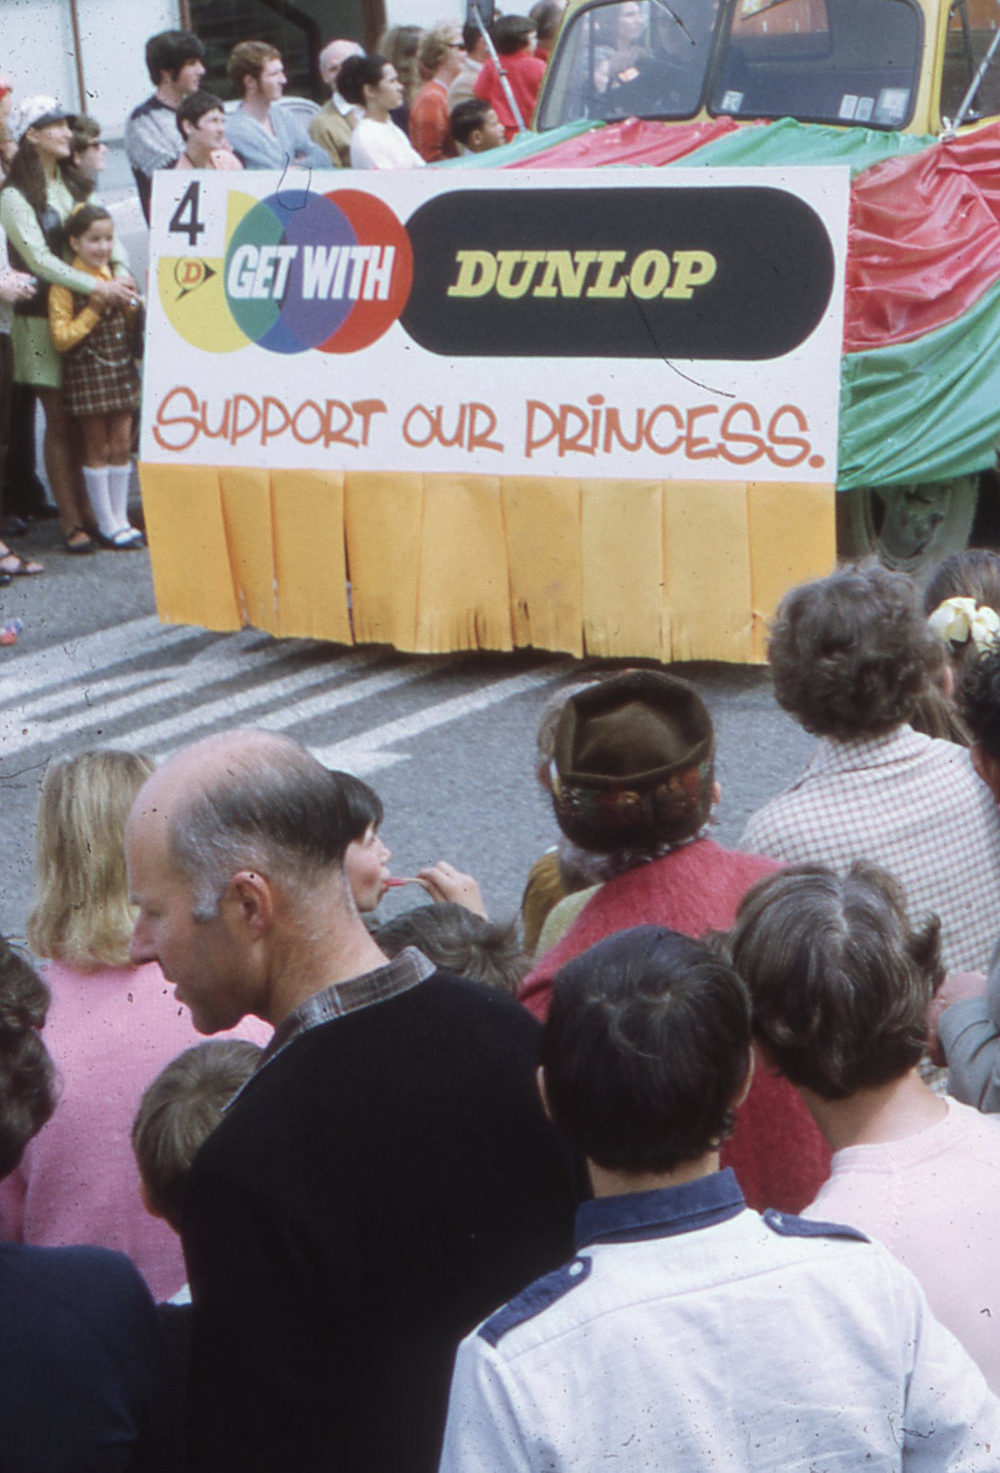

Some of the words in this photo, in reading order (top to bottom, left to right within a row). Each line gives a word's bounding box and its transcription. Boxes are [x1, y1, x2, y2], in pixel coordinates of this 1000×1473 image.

[168, 180, 205, 246] 4
[183, 263, 202, 284] D
[227, 244, 298, 300] GET
[301, 245, 396, 301] WITH
[447, 249, 717, 300] DUNLOP
